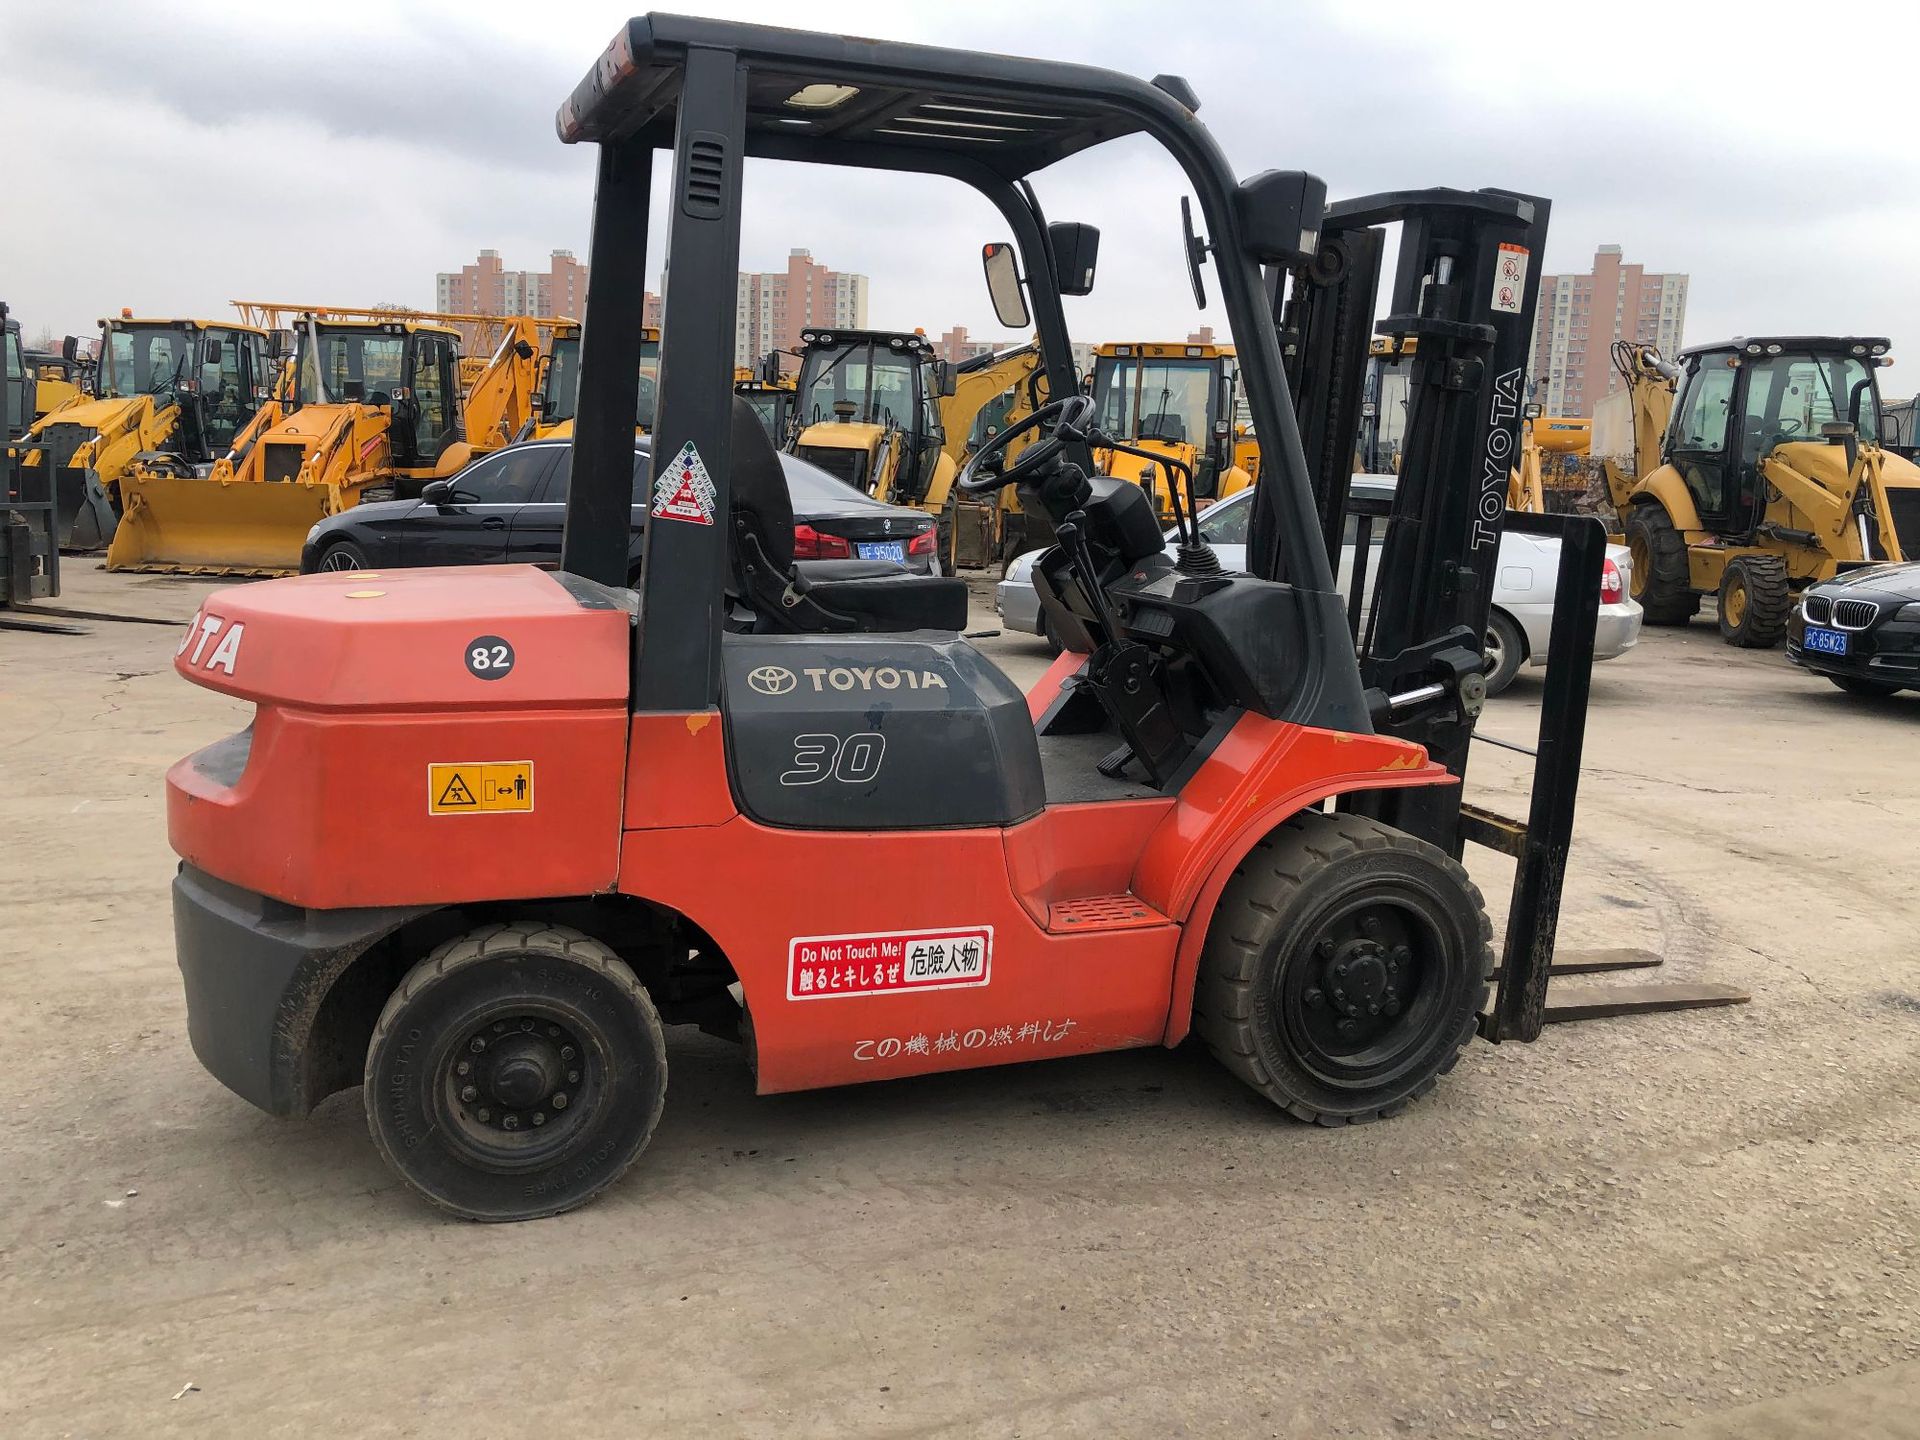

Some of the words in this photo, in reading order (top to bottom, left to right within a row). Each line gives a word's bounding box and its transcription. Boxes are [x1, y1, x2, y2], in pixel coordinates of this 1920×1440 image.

[1471, 367, 1522, 550] TOYOTA
[471, 645, 510, 670] 82
[804, 667, 948, 692] TOYOTA
[780, 732, 886, 786] 30
[801, 947, 817, 963] Do
[820, 945, 842, 961] Not
[845, 942, 877, 960] Touch
[881, 941, 902, 957] Me!
